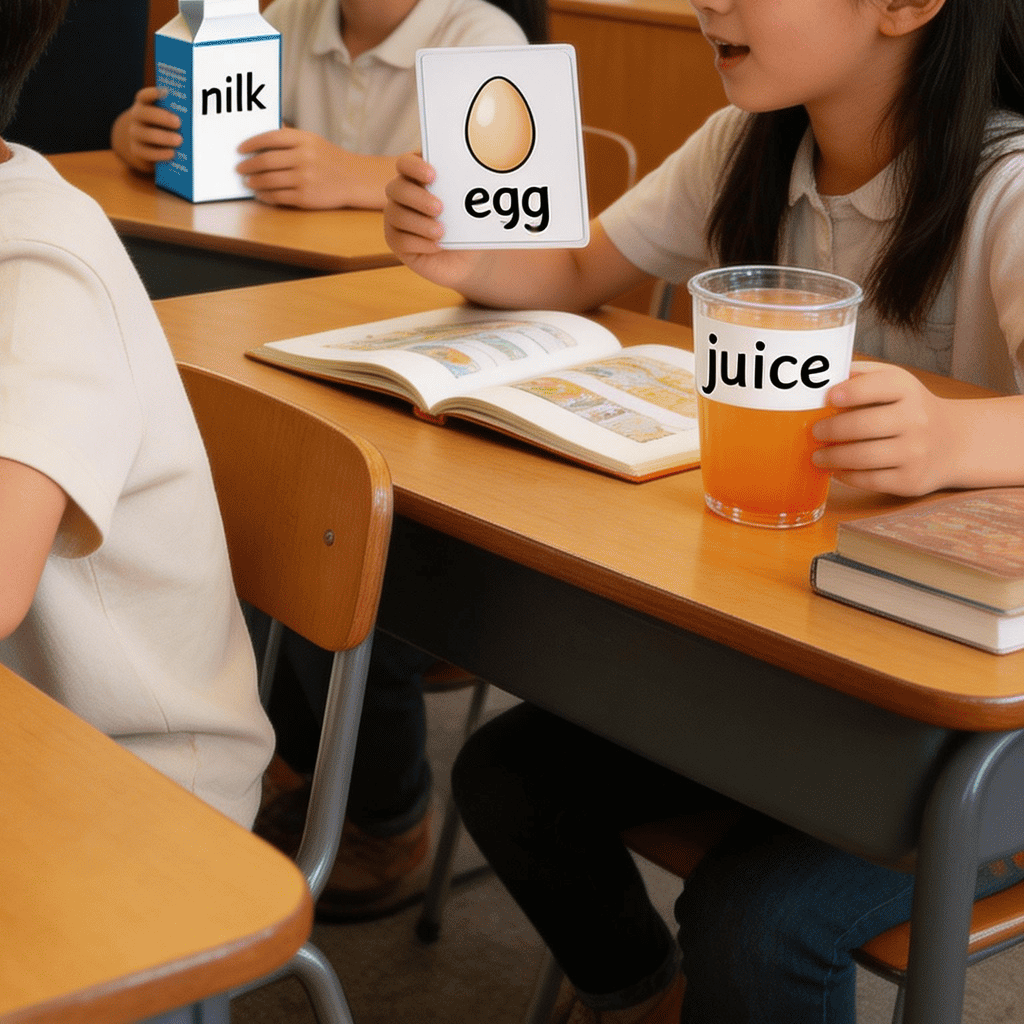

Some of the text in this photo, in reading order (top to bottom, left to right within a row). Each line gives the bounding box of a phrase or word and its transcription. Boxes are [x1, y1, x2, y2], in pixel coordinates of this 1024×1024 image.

[201, 71, 267, 116] nilk
[464, 186, 550, 233] egg
[701, 333, 830, 395] juice
